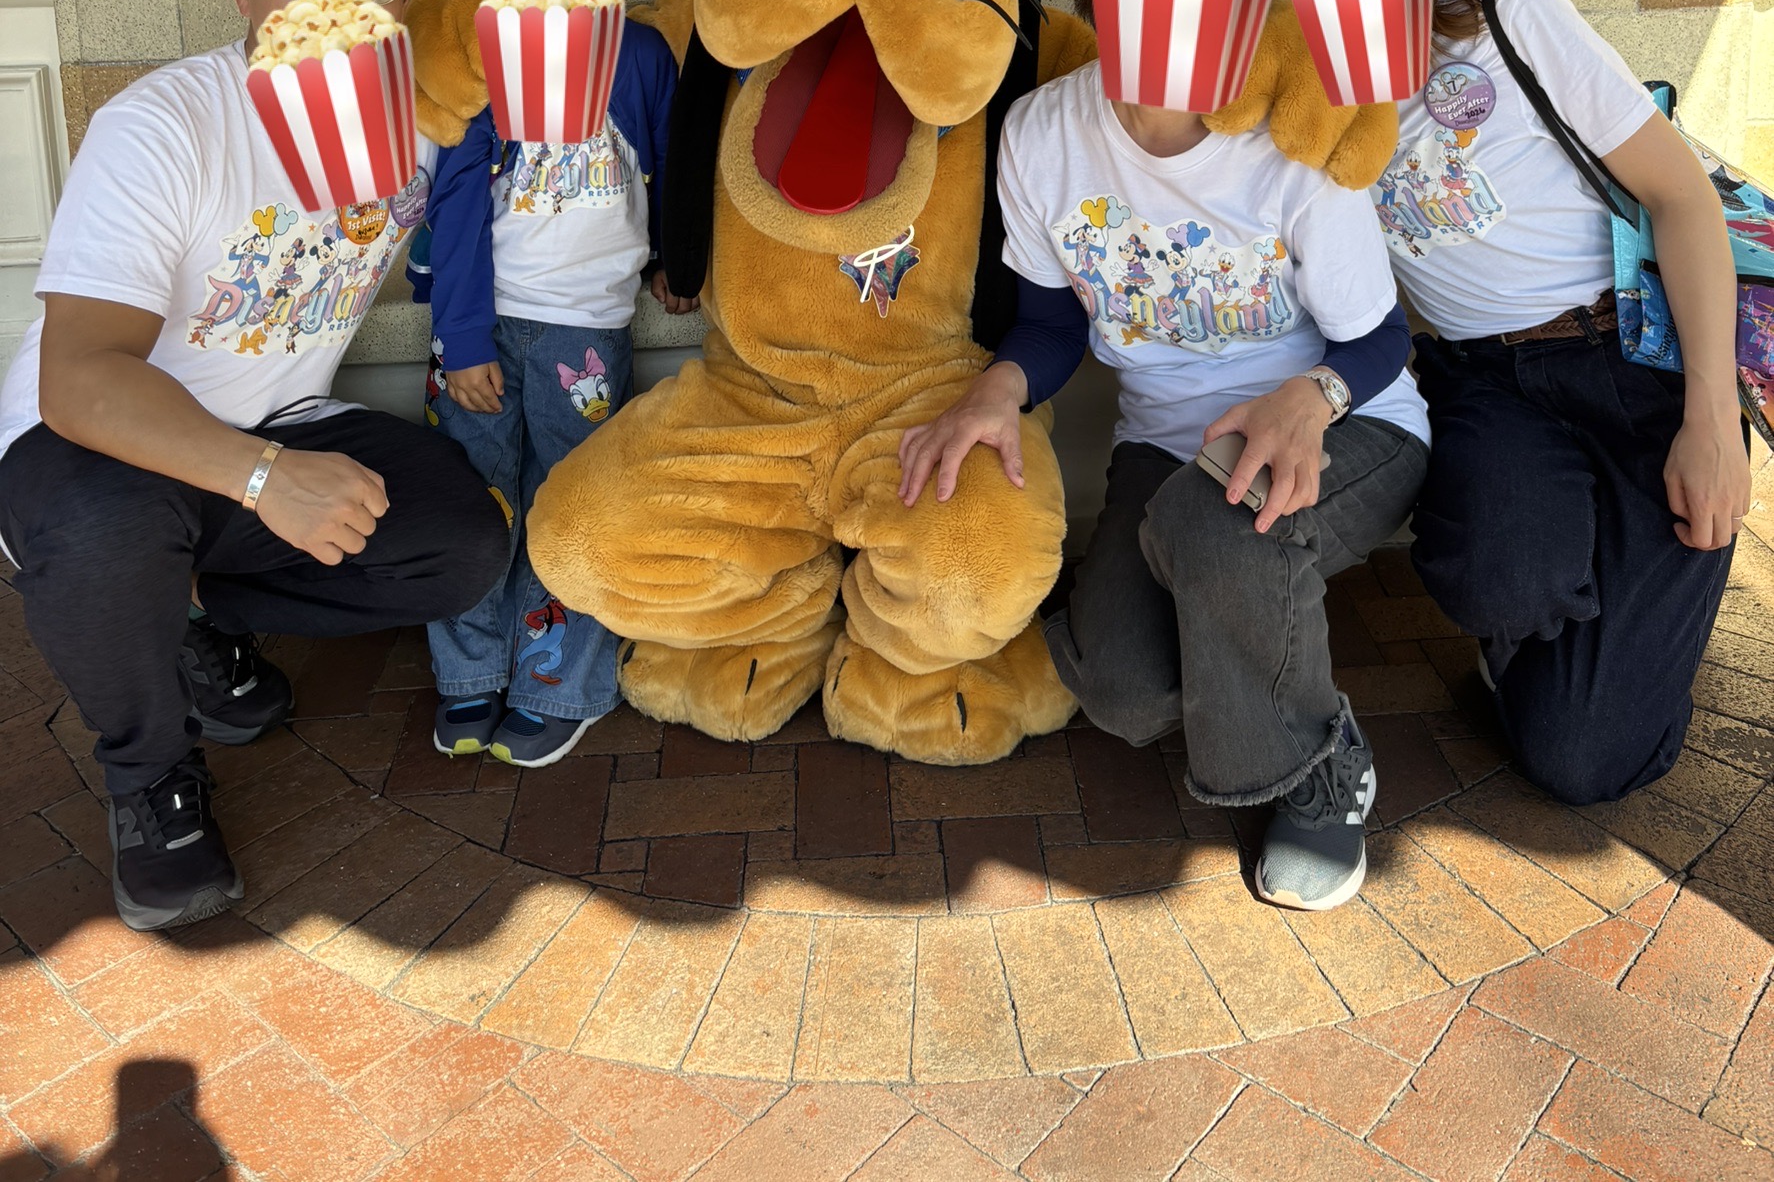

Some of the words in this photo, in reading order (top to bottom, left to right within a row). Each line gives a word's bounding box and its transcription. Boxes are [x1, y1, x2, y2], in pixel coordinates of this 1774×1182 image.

[1434, 95, 1468, 114] Happily
[1448, 106, 1466, 120] Ever
[1467, 97, 1490, 110] After
[347, 220, 360, 231] 1st
[362, 211, 386, 226] Visit!
[189, 272, 376, 335] Disneylan
[1065, 271, 1293, 342] Disneyland
